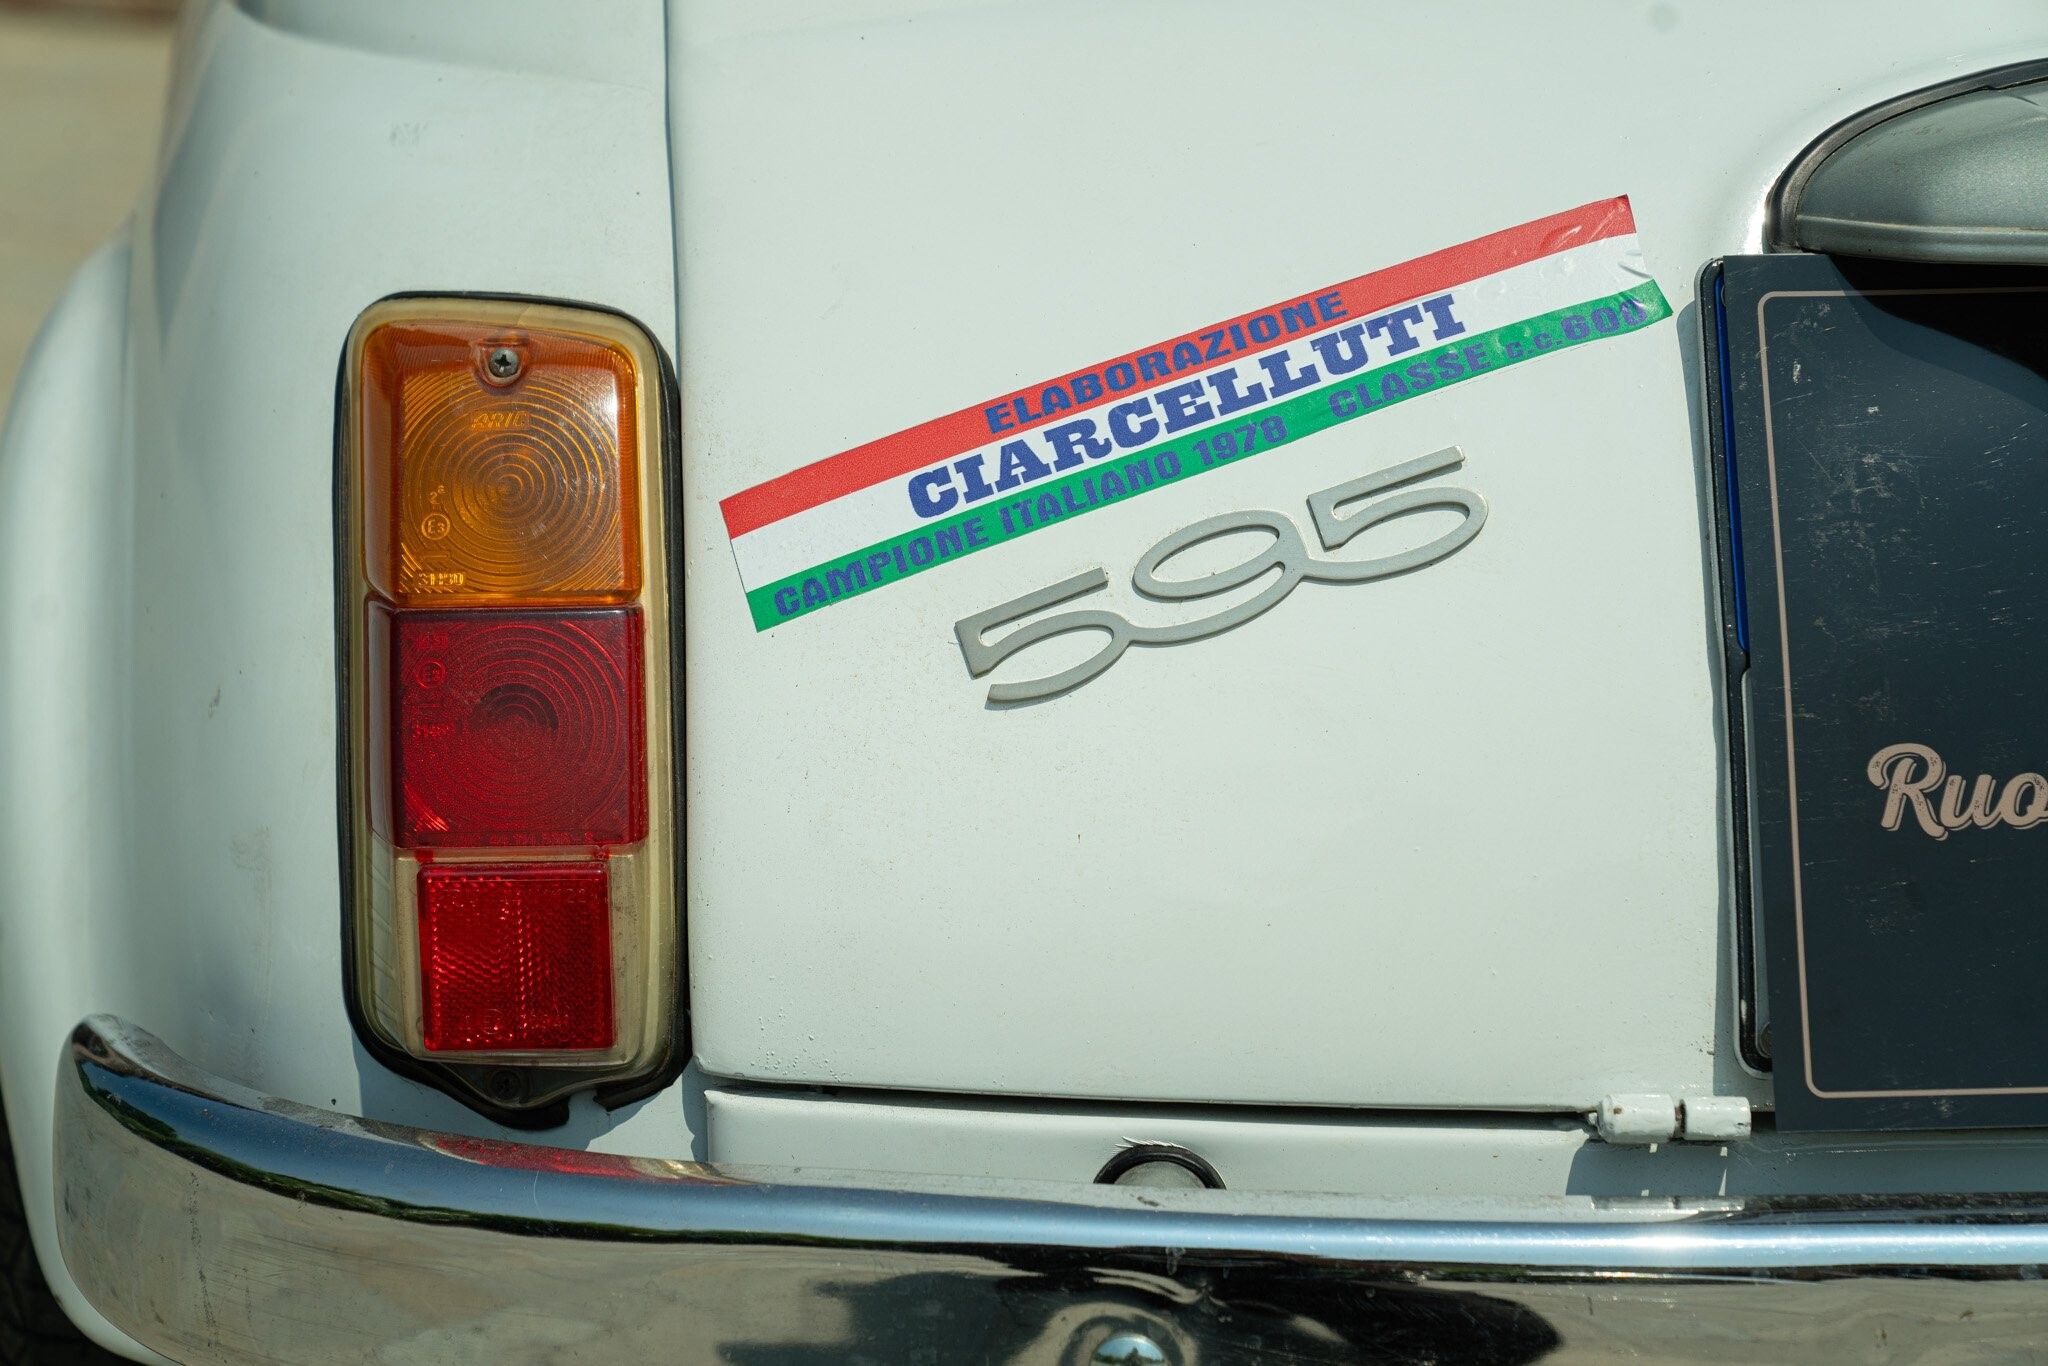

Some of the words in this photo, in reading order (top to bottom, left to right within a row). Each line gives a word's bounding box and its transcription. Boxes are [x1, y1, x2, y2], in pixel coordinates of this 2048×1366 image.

[906, 293, 1467, 520] CIARCELLUTI
[985, 291, 1348, 435] ELABORAZIONE
[773, 516, 989, 617] CAMPIONE
[999, 450, 1182, 534] ITALIANO
[1193, 414, 1288, 466] 1978
[1327, 342, 1491, 418] CLASSE
[954, 444, 1489, 704] 595
[1866, 742, 2048, 841] Ruo
